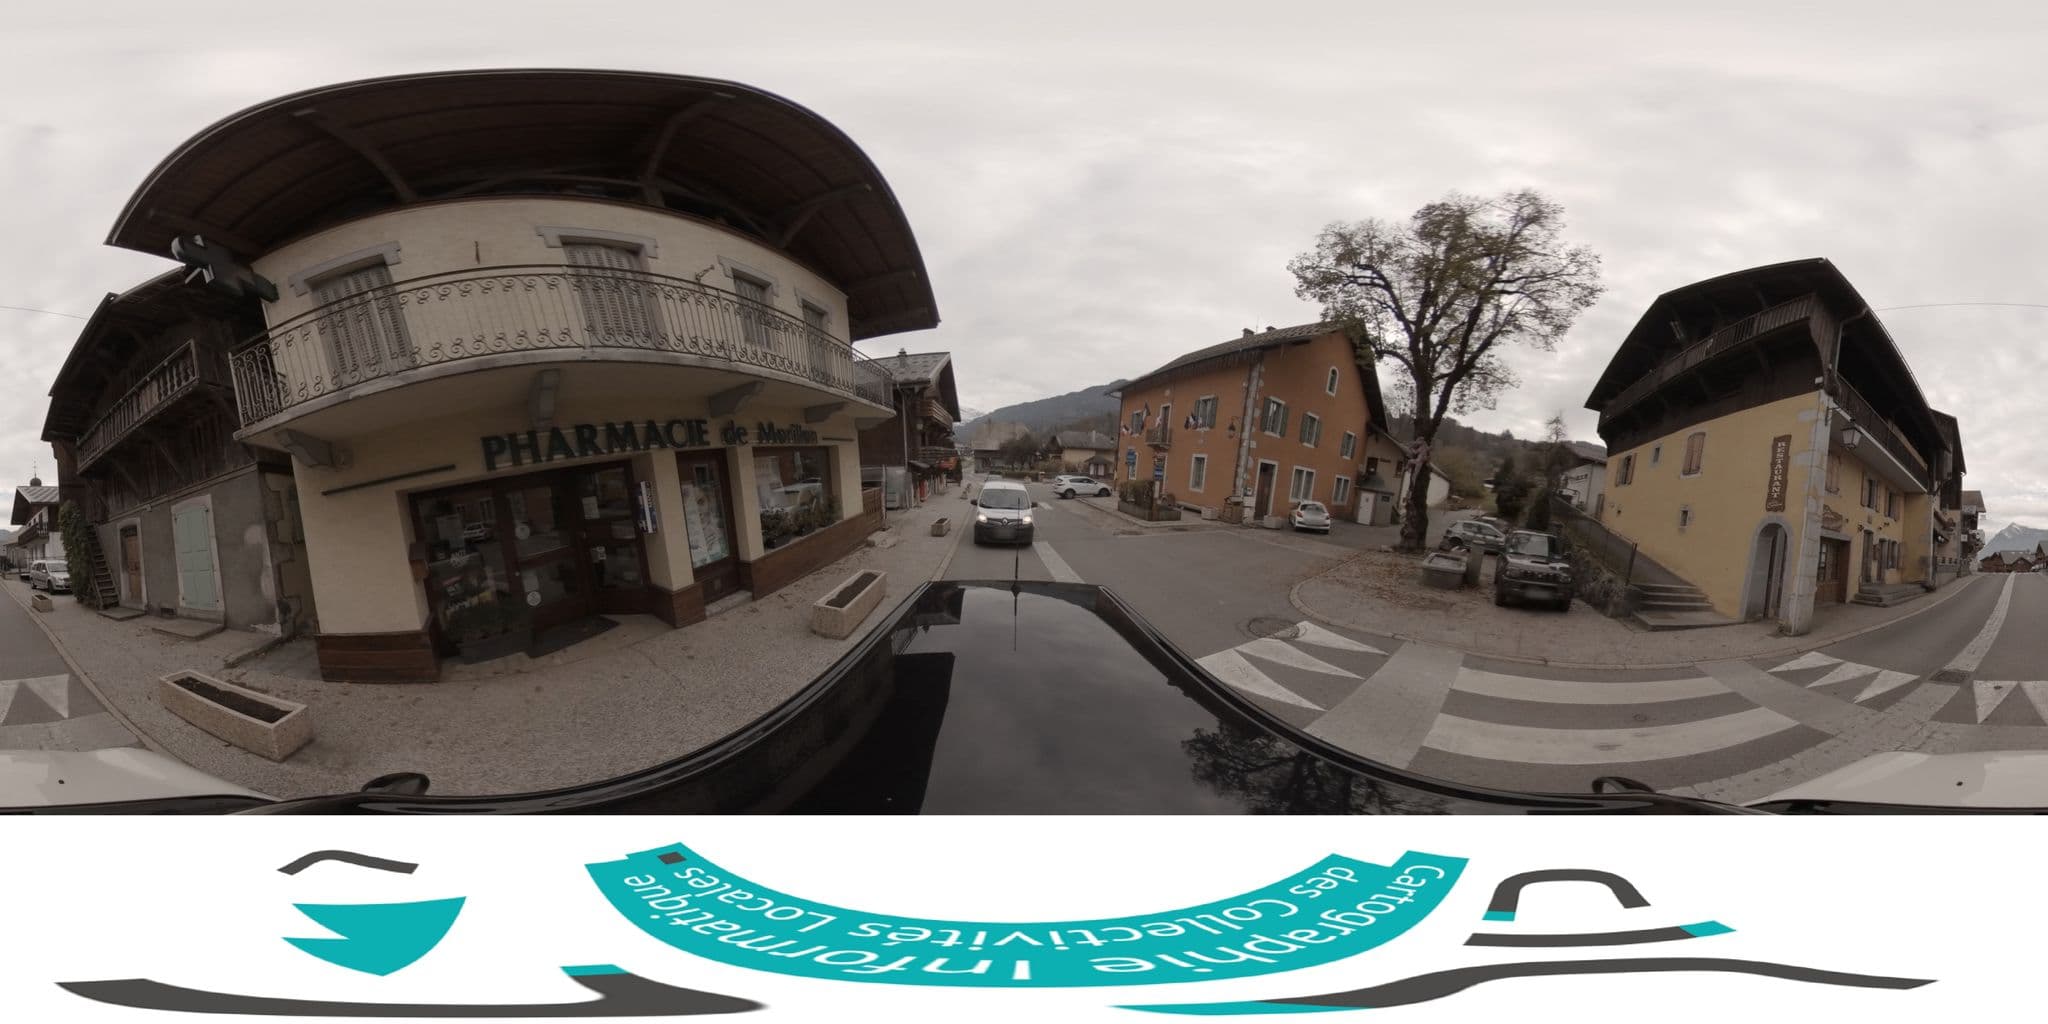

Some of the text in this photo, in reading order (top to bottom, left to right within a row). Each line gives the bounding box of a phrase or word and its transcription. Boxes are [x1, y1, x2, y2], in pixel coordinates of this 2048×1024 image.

[481, 418, 709, 470] PHARMACIE
[721, 420, 748, 444] de
[1771, 441, 1786, 498] RESTAURANT
